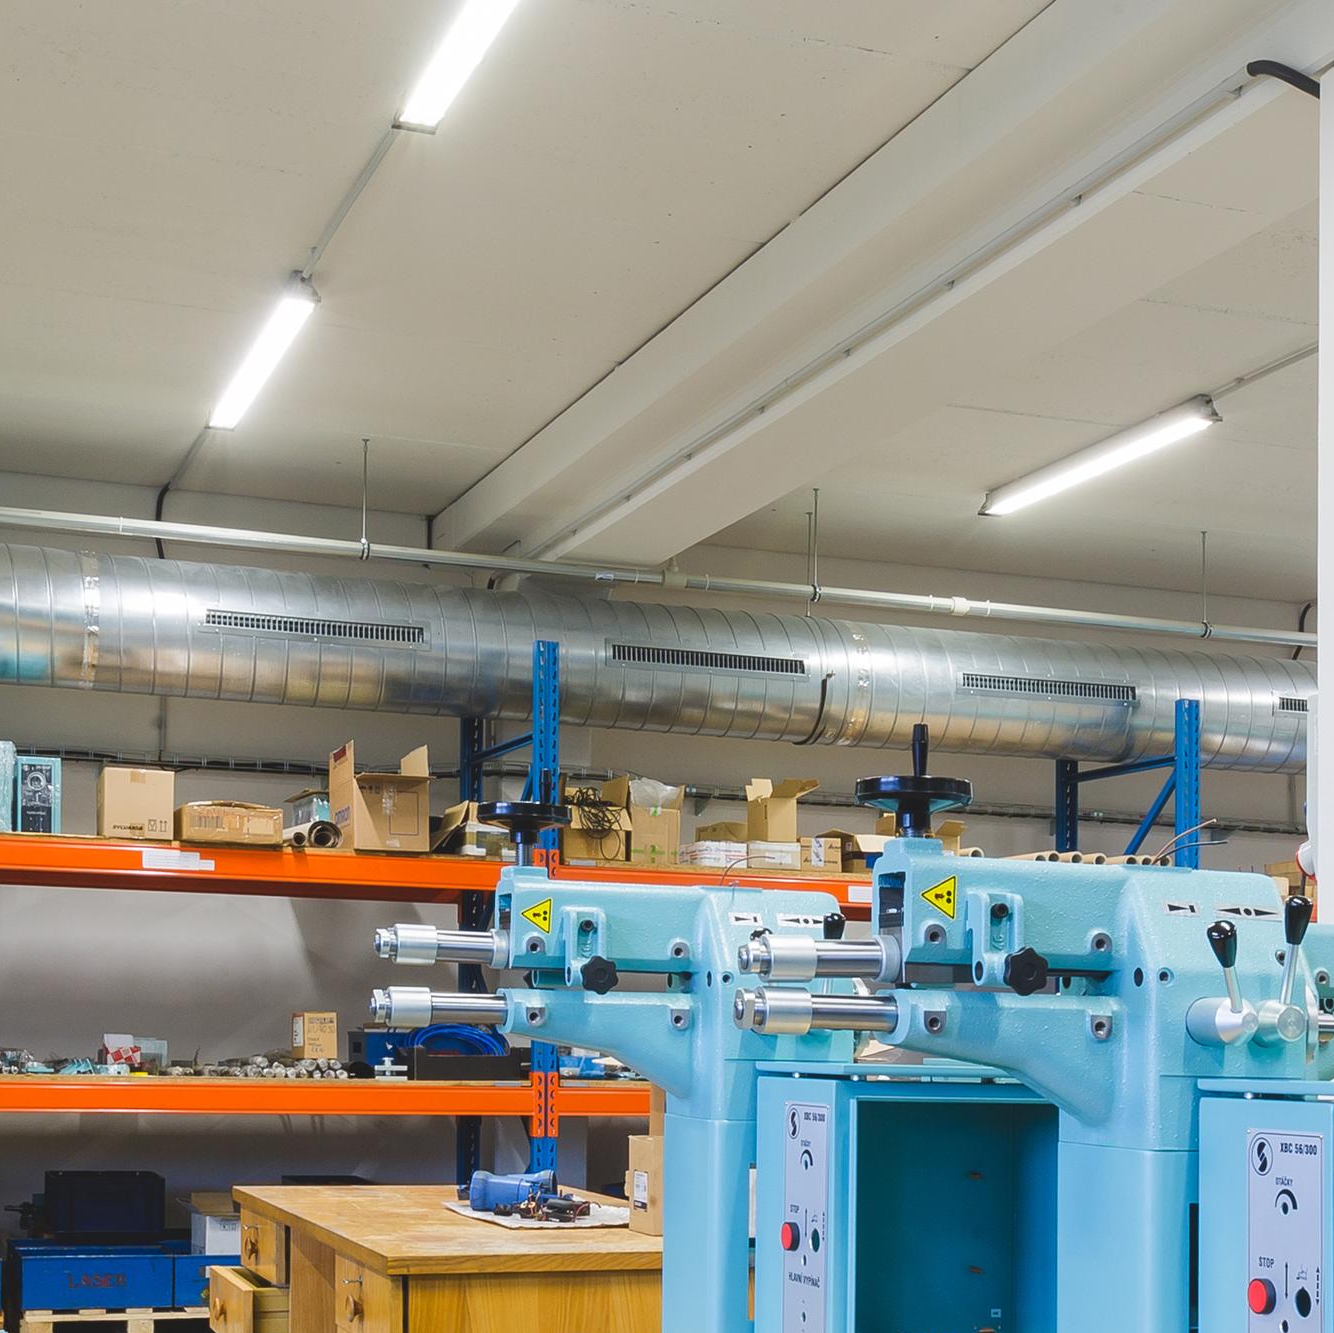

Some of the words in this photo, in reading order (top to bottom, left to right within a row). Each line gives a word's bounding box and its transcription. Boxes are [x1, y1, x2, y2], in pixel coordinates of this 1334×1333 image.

[1279, 1142, 1293, 1154] XBC
[1294, 1143, 1318, 1156] 56/300
[1258, 1255, 1275, 1269] STOP
